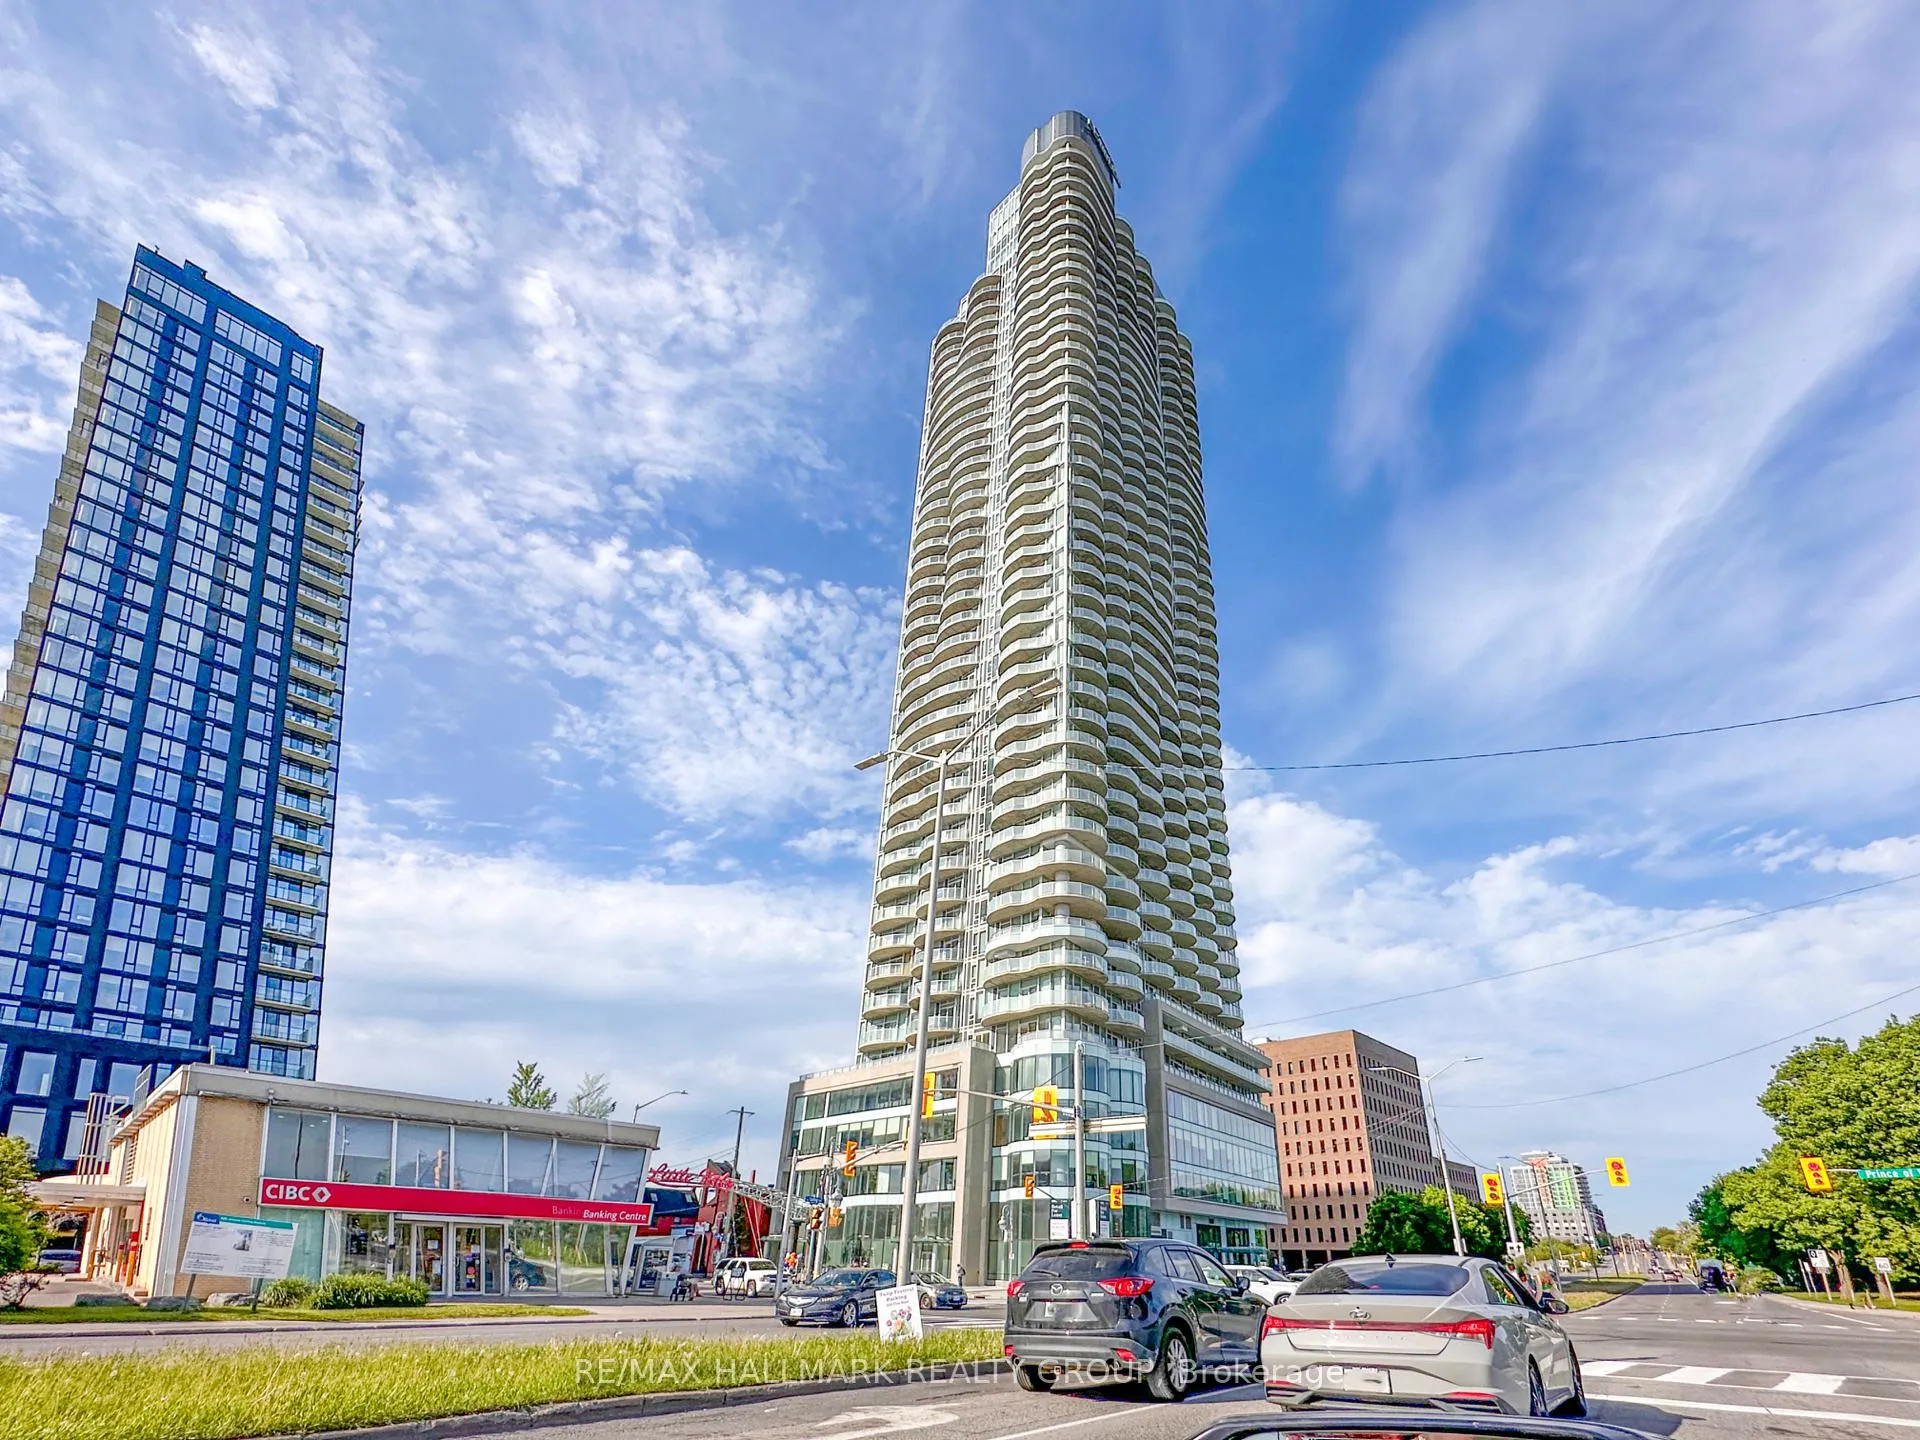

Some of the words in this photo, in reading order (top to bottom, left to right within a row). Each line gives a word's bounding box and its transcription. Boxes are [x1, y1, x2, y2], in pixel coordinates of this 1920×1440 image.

[1865, 1169, 1899, 1179] Prince
[265, 1183, 311, 1201] CIBC
[583, 1209, 617, 1221] Banking
[619, 1211, 647, 1221] Centre
